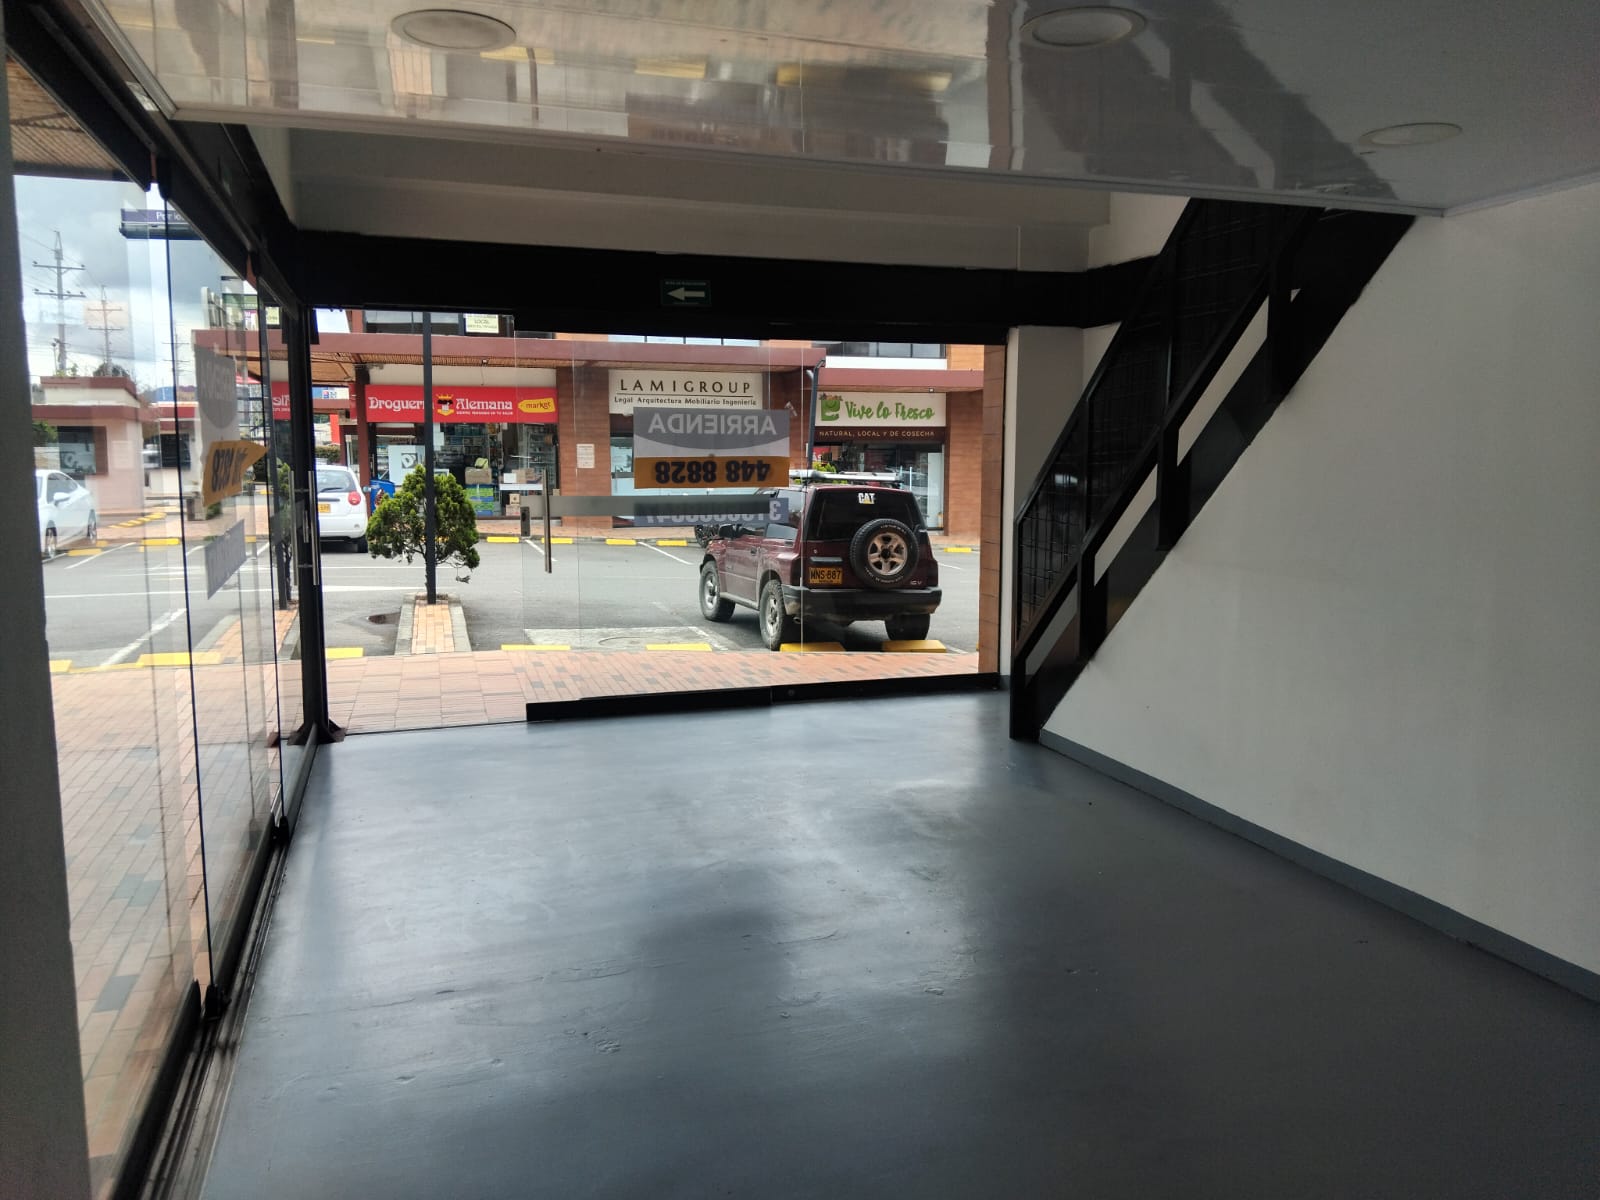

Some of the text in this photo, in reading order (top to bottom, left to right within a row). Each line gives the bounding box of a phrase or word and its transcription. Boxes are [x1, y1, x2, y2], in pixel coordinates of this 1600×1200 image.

[620, 379, 750, 394] LAMIGROUP
[367, 396, 513, 412] Droguer Alemana
[614, 396, 633, 404] Legal
[637, 397, 682, 405] Arquitectura
[684, 397, 721, 405] Mobiliario
[844, 401, 935, 420] Vive lo Fresco
[819, 430, 855, 438] NATURAL,
[655, 460, 771, 484] 448 8828
[858, 492, 876, 505] CAT
